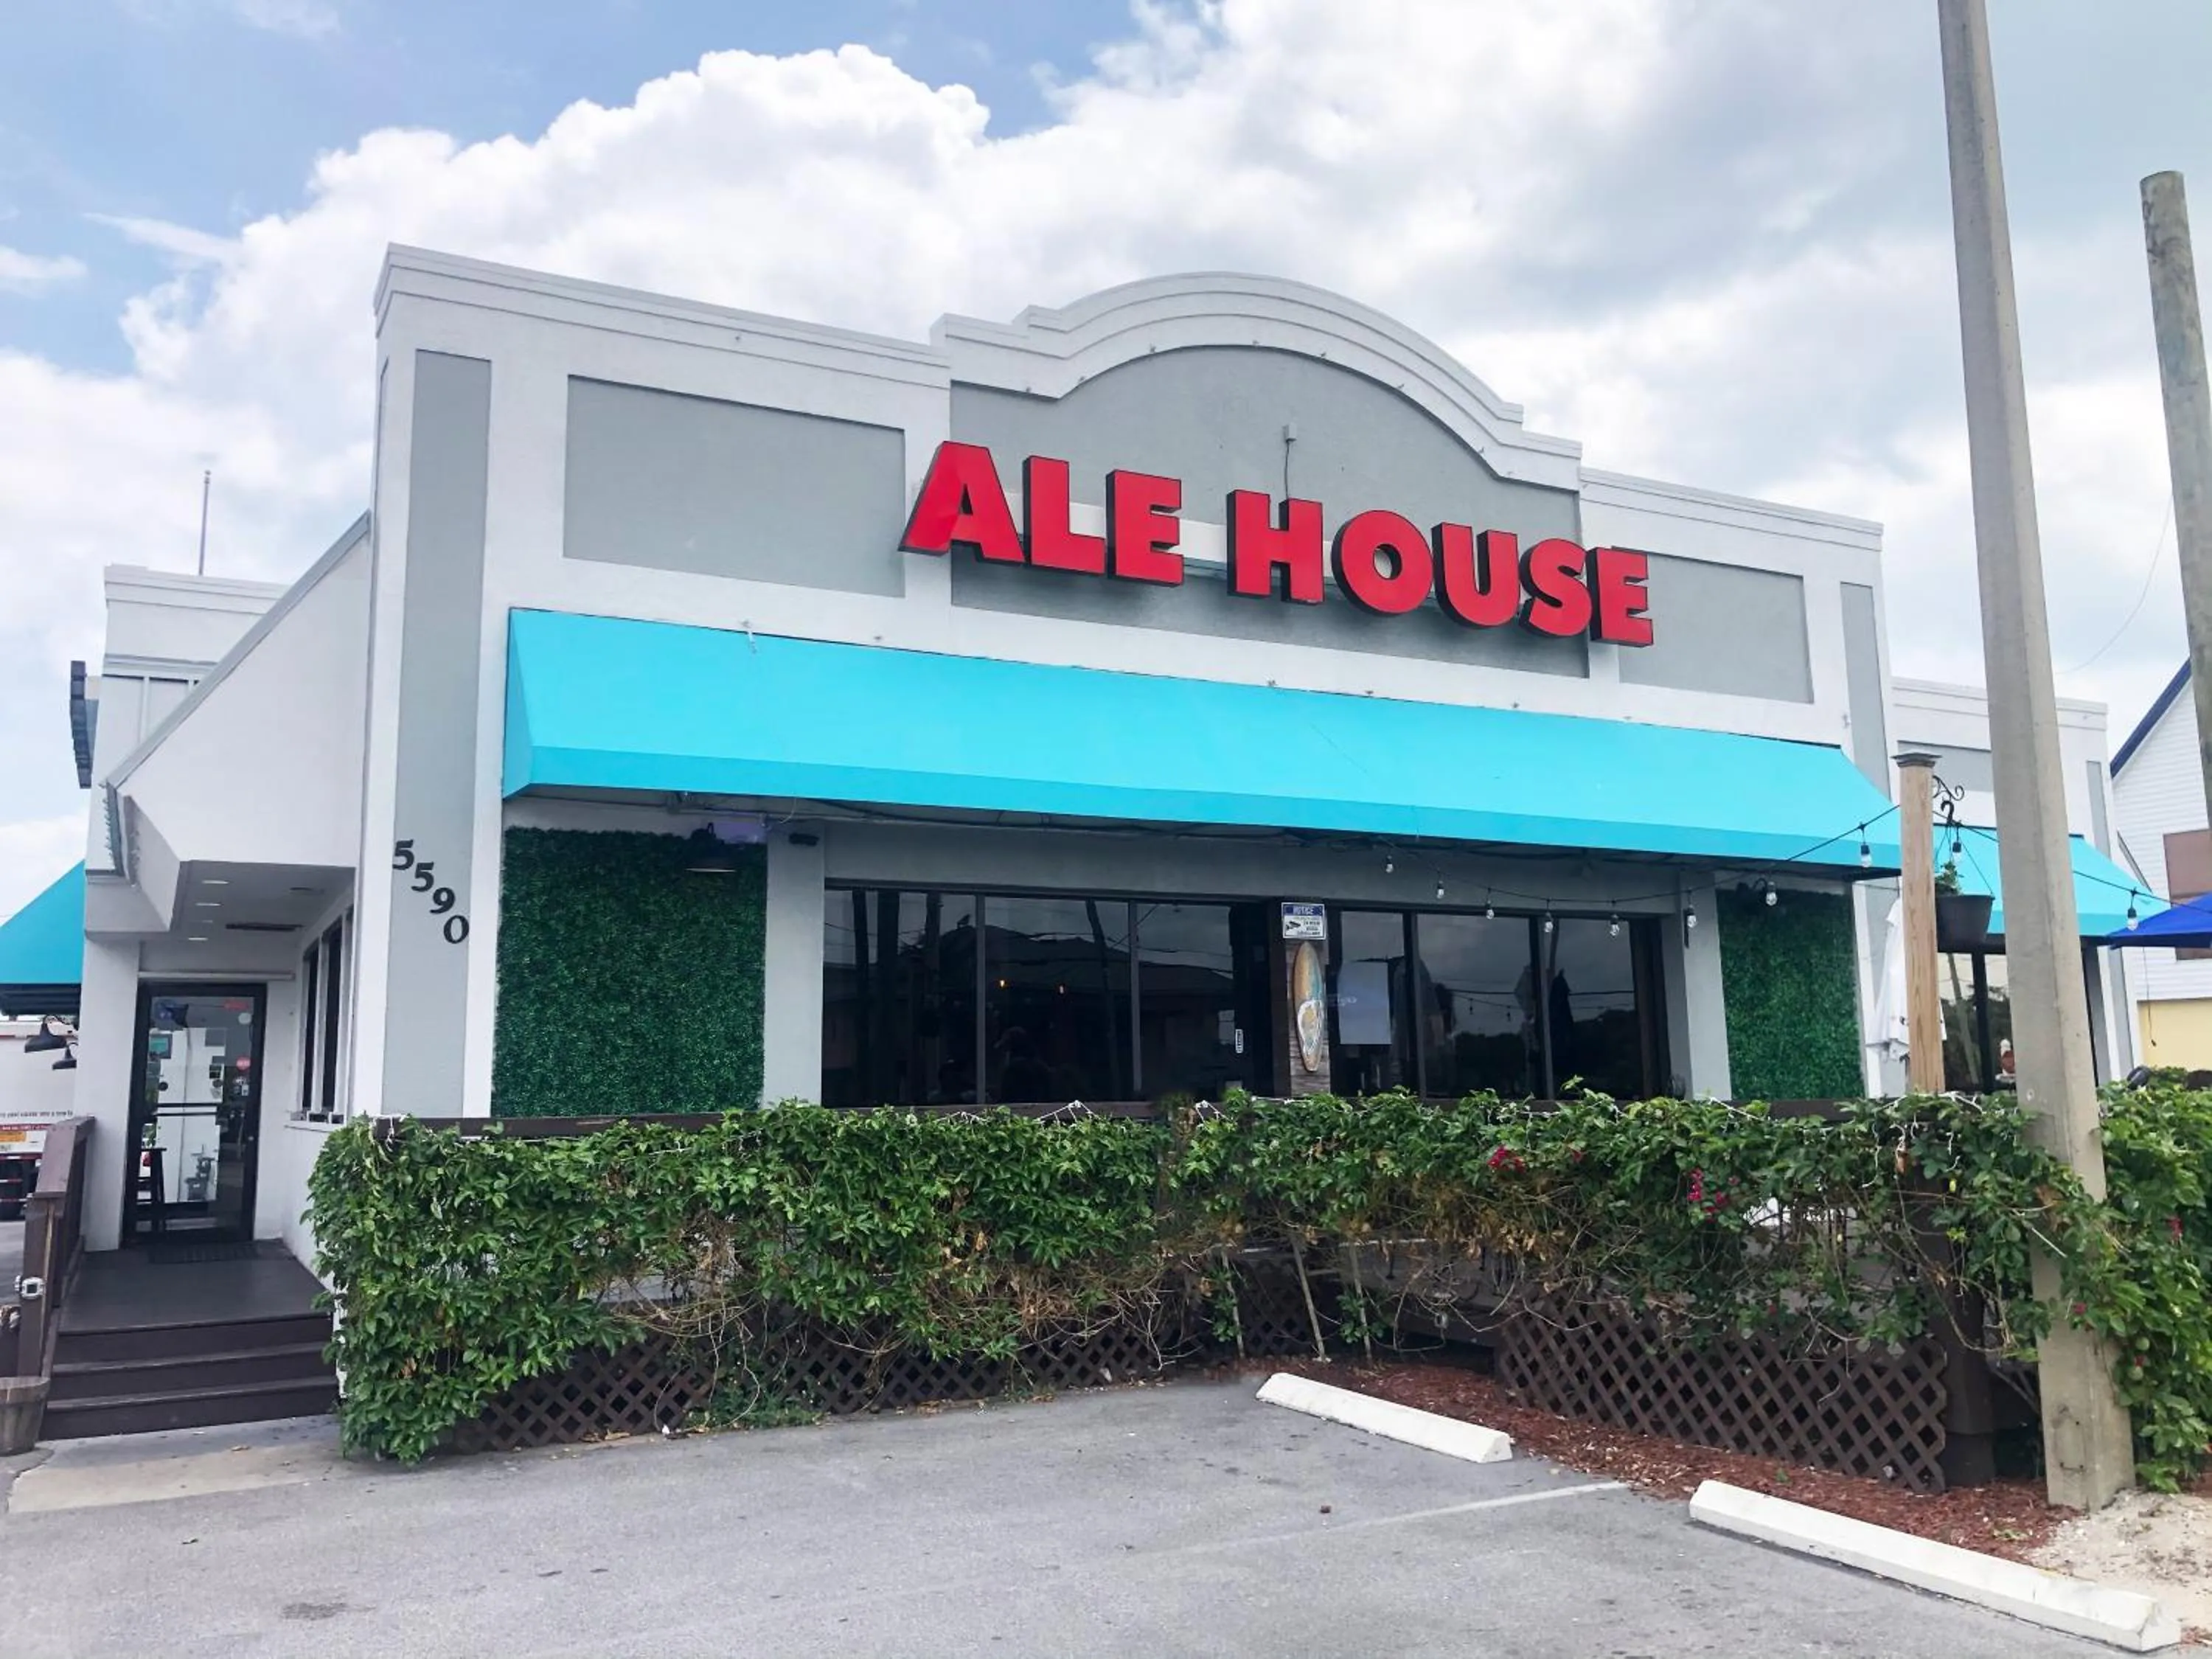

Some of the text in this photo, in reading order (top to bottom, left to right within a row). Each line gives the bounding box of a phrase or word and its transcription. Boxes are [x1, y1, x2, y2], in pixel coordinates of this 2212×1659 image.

[897, 441, 1654, 647] ALE HOUSE
[392, 839, 470, 944] 5590
